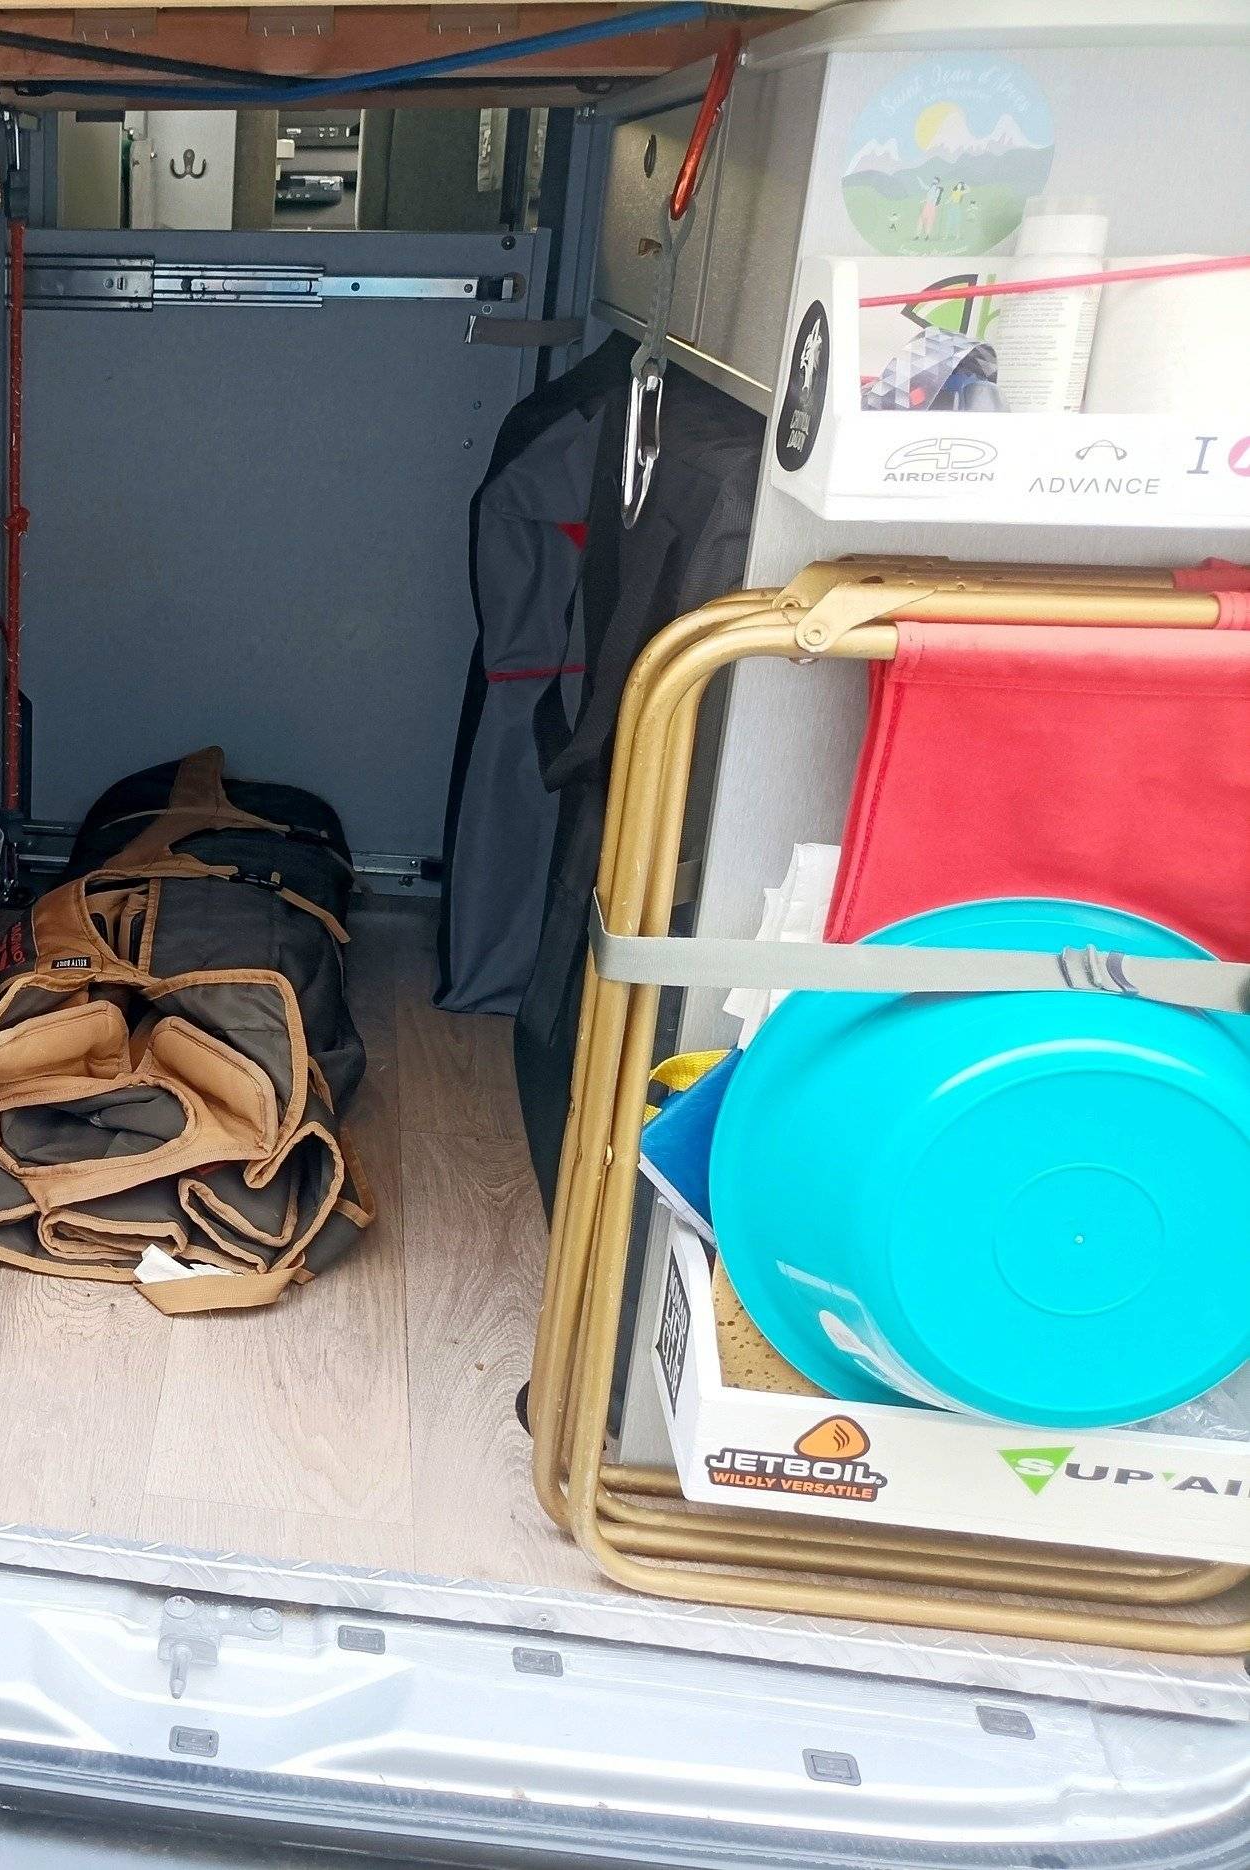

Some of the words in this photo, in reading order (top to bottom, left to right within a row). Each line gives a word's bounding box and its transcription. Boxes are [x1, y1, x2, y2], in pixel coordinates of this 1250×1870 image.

[883, 472, 995, 483] AIRDESIGN
[1028, 477, 1161, 495] ADVANCE
[664, 1291, 684, 1374] LIFE
[661, 1321, 679, 1399] CLUB
[712, 1472, 777, 1490] WILDLY
[781, 1480, 874, 1500] VERSATILE
